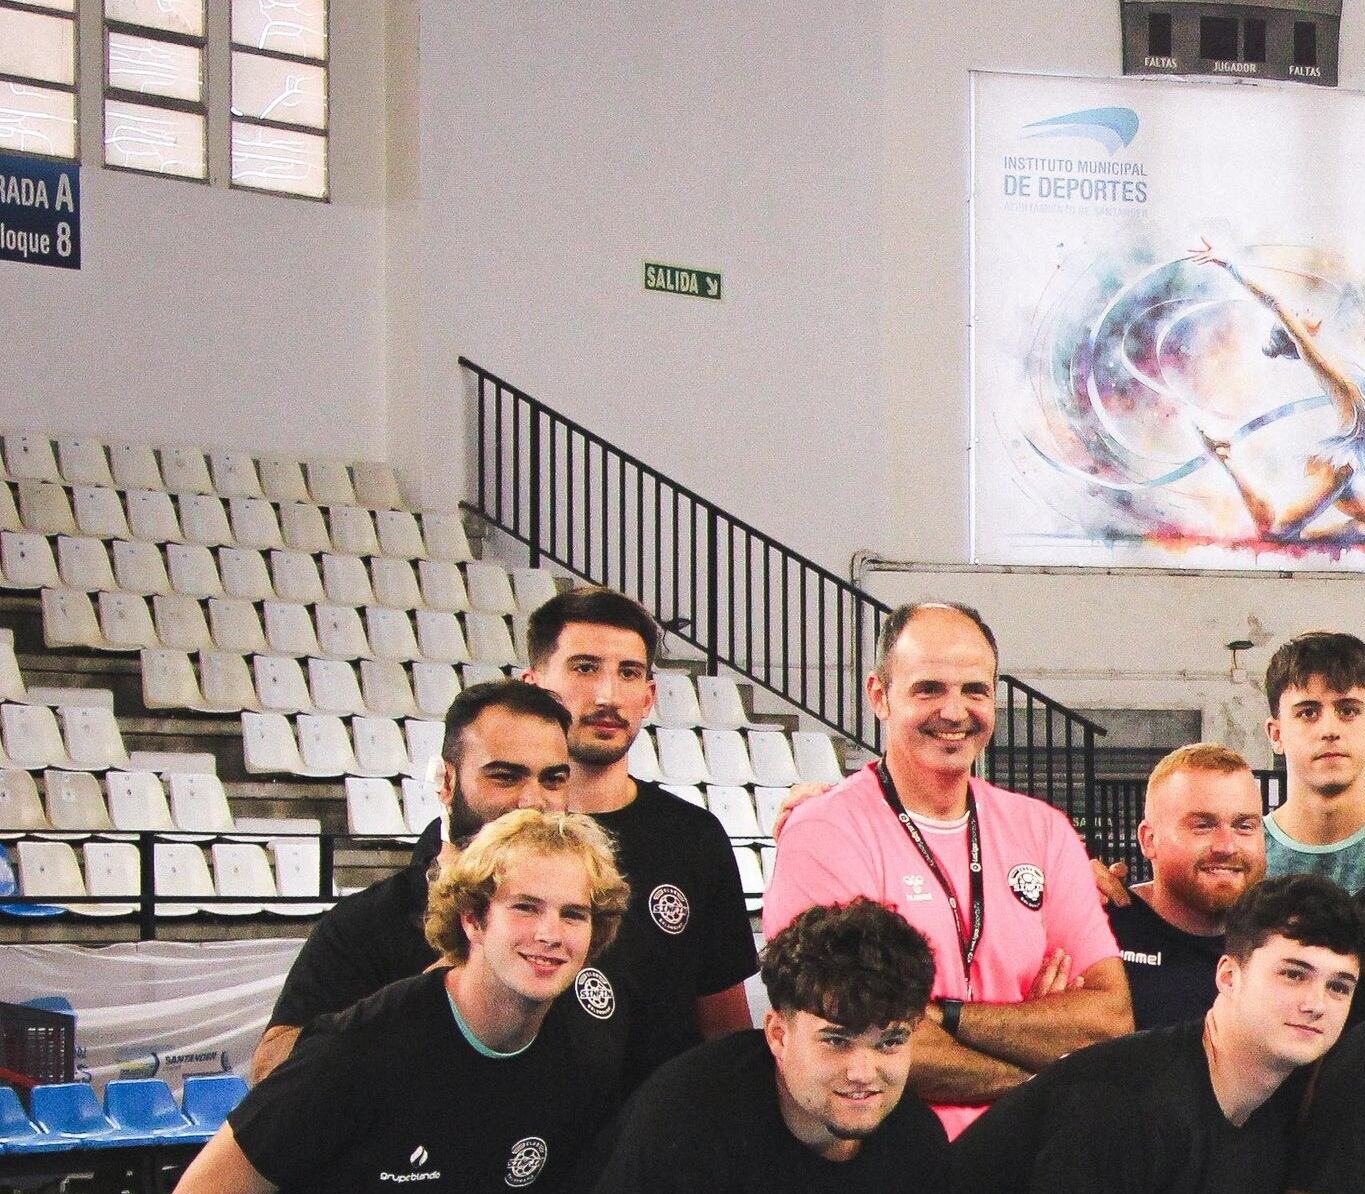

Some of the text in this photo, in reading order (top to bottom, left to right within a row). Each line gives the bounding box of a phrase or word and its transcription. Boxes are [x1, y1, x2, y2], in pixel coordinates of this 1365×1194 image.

[1144, 56, 1177, 69] FALTAS
[1213, 61, 1257, 73] JUGADOR
[1289, 65, 1321, 77] FALTAS
[1004, 156, 1148, 177] INSTITUTO MUNICIPAL
[55, 173, 74, 212] A
[1003, 174, 1148, 203] DE DEPORTES
[56, 221, 72, 257] 8
[647, 266, 699, 294] SALIDA
[1119, 950, 1162, 966] mmel
